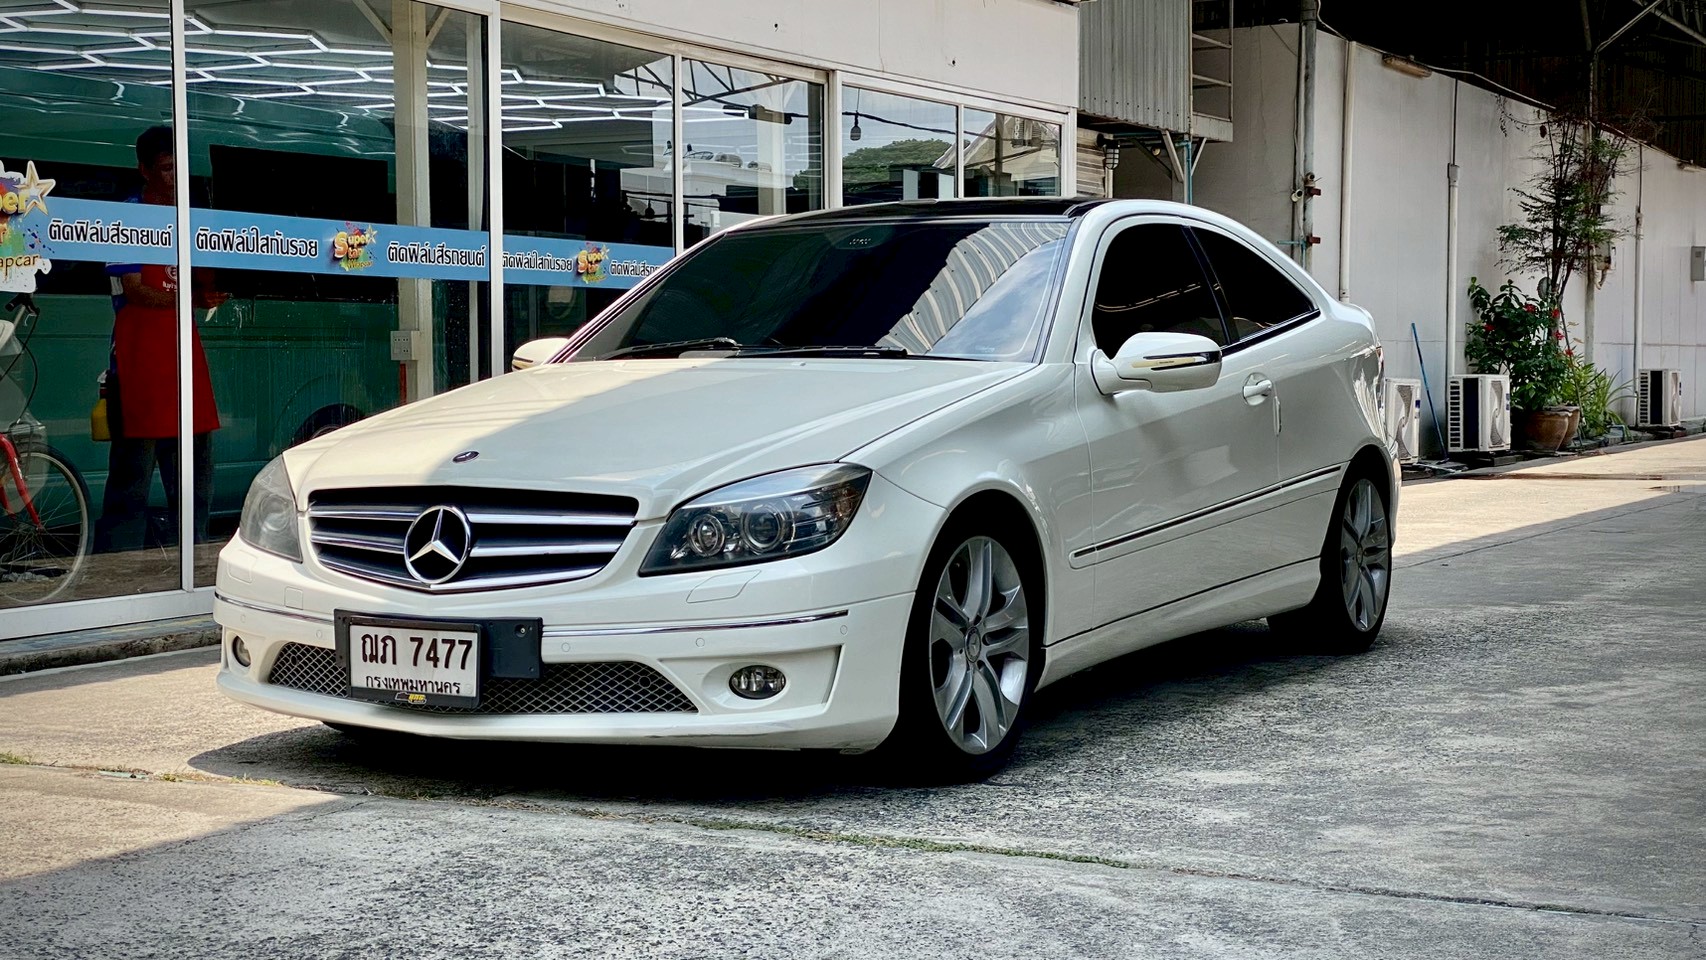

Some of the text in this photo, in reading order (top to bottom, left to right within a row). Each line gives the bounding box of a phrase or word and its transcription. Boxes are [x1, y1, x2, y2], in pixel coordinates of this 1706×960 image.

[49, 219, 172, 247] ติดฟิล์มสีรถยนต์
[196, 227, 318, 257] ติดฟิล์มใสกันรอย
[388, 242, 485, 266] ติดฟิล์มสีรถยนต์
[409, 636, 473, 670] 7477
[365, 675, 461, 694] กรงเทพมหานคร
